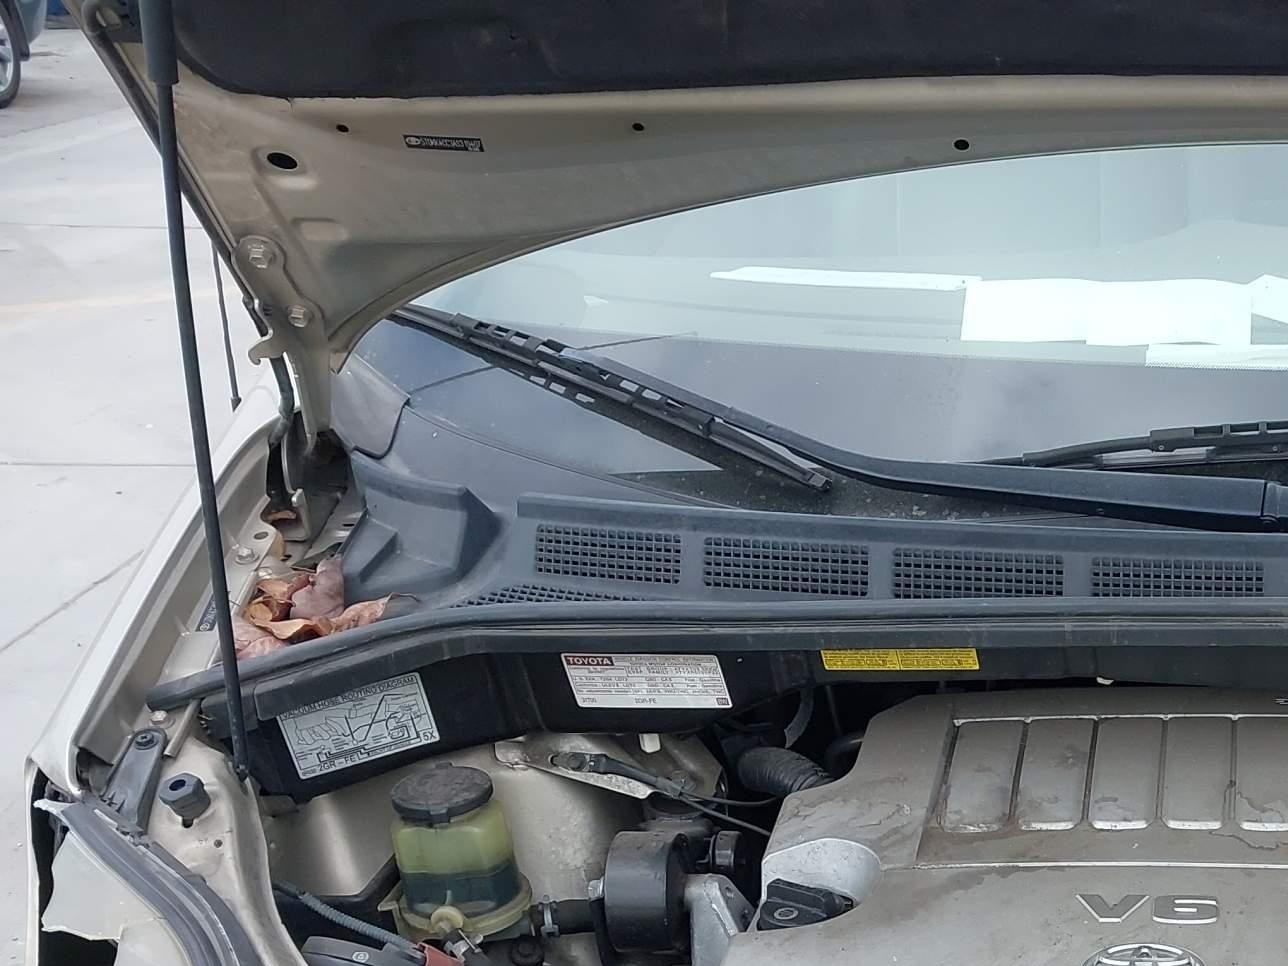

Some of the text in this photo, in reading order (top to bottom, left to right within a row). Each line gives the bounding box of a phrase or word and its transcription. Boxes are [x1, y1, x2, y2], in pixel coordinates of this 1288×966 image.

[567, 656, 612, 665] TOYOTA
[378, 677, 415, 691] DIAGRAM
[422, 731, 436, 741] 5X
[318, 756, 360, 772] 2GR-FE
[1075, 893, 1218, 925] V6
